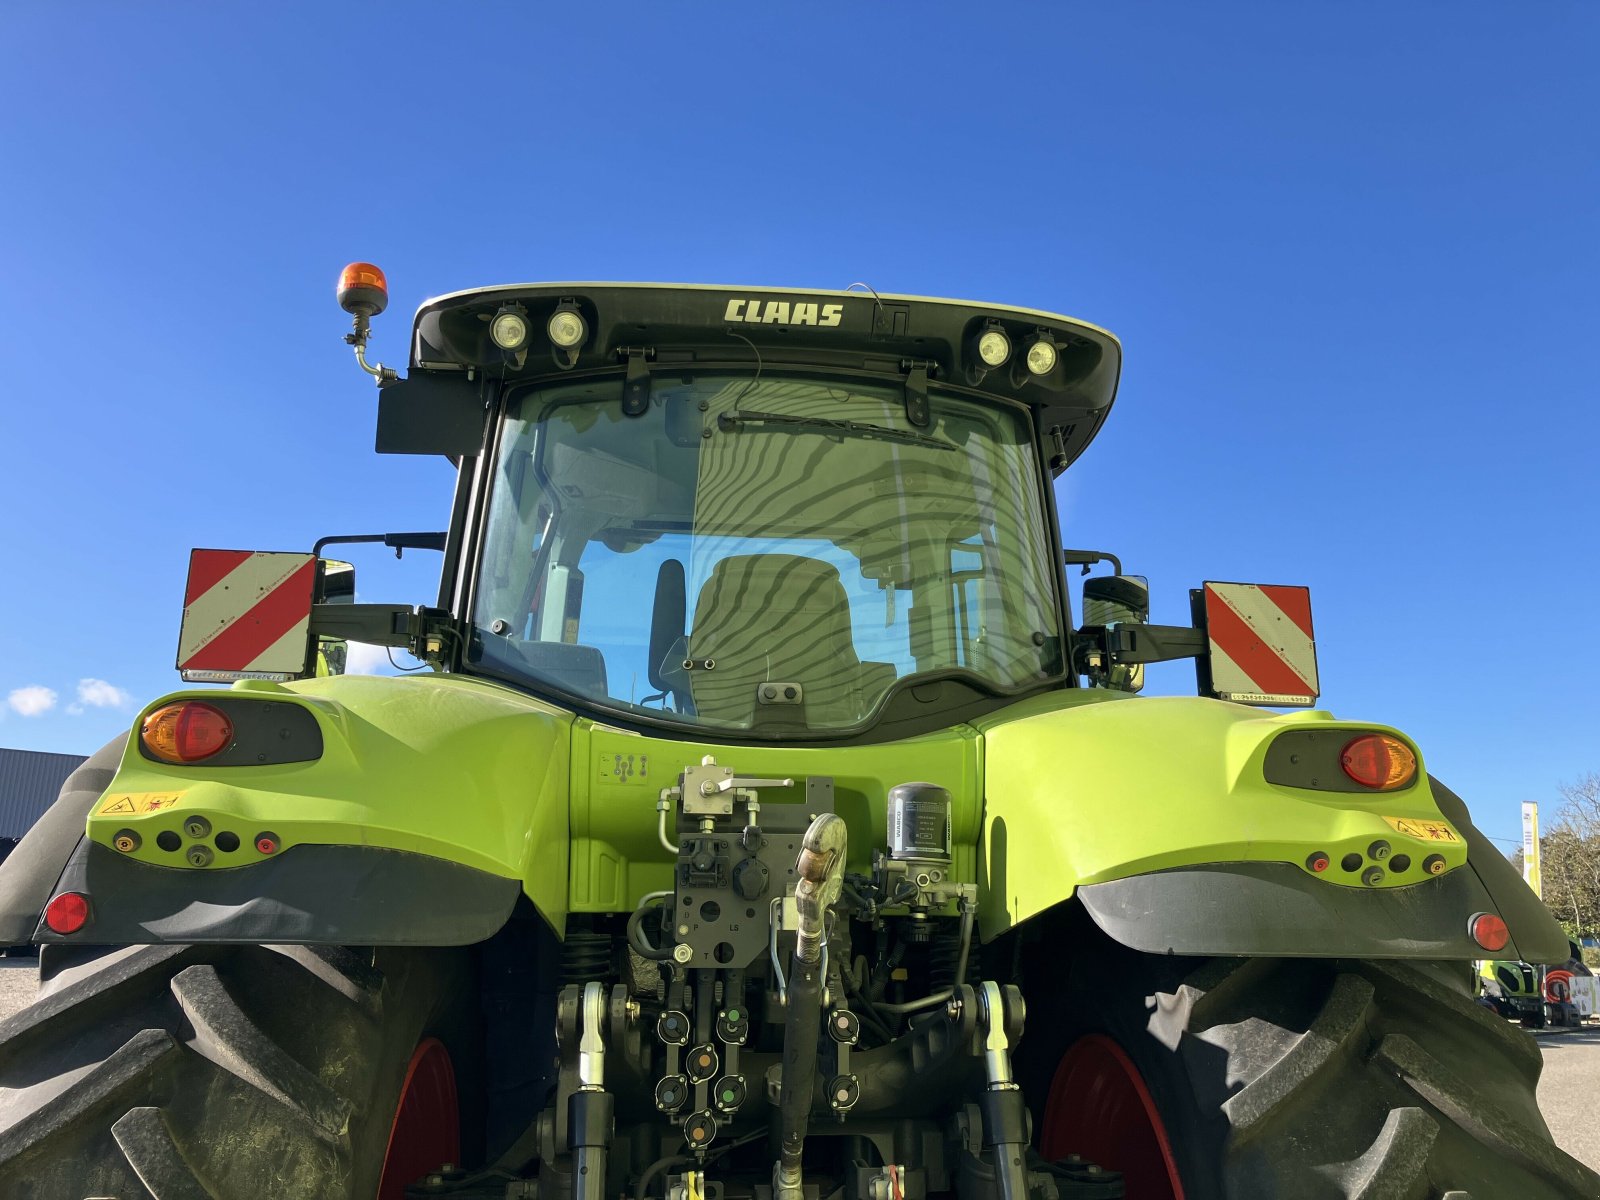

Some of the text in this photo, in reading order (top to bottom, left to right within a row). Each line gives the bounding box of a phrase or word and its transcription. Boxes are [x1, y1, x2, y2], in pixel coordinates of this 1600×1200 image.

[724, 299, 844, 327] CLAAS
[693, 923, 699, 931] P
[729, 923, 739, 932] LS
[703, 952, 709, 960] T
